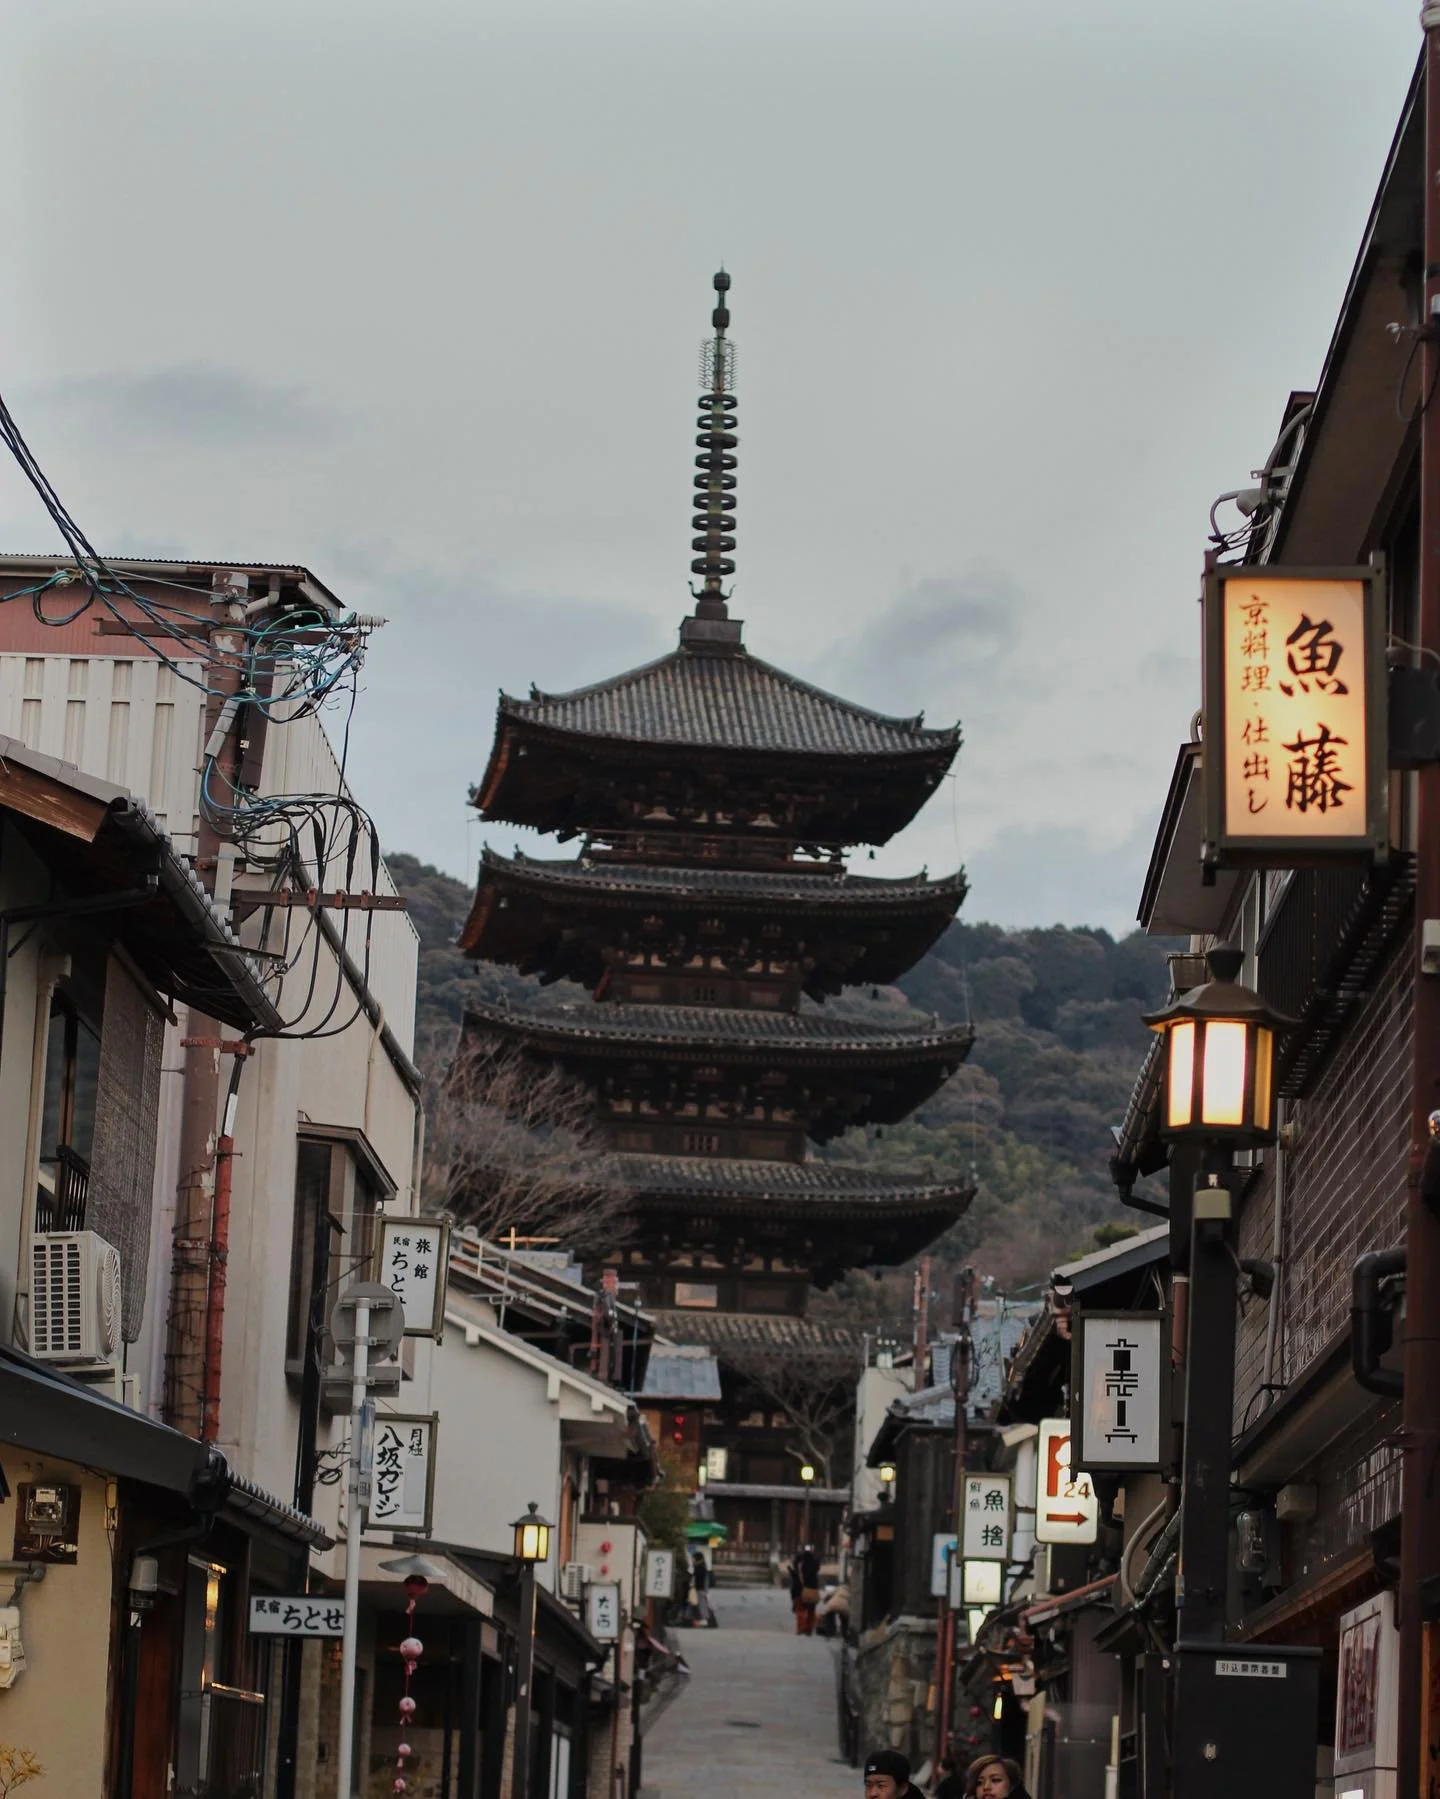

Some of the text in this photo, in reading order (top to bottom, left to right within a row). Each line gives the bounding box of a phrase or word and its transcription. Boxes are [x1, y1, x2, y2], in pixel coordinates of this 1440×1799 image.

[1278, 612, 1354, 814] 魚藤
[392, 1236, 410, 1247] 民宿
[414, 1238, 432, 1279] 旅館
[391, 1251, 408, 1305] ちと
[408, 1428, 424, 1456] 月極
[376, 1425, 404, 1518] 八坂ガレージ
[981, 1490, 1004, 1546] 魚捨
[255, 1599, 344, 1630] 民宿 ちとせ
